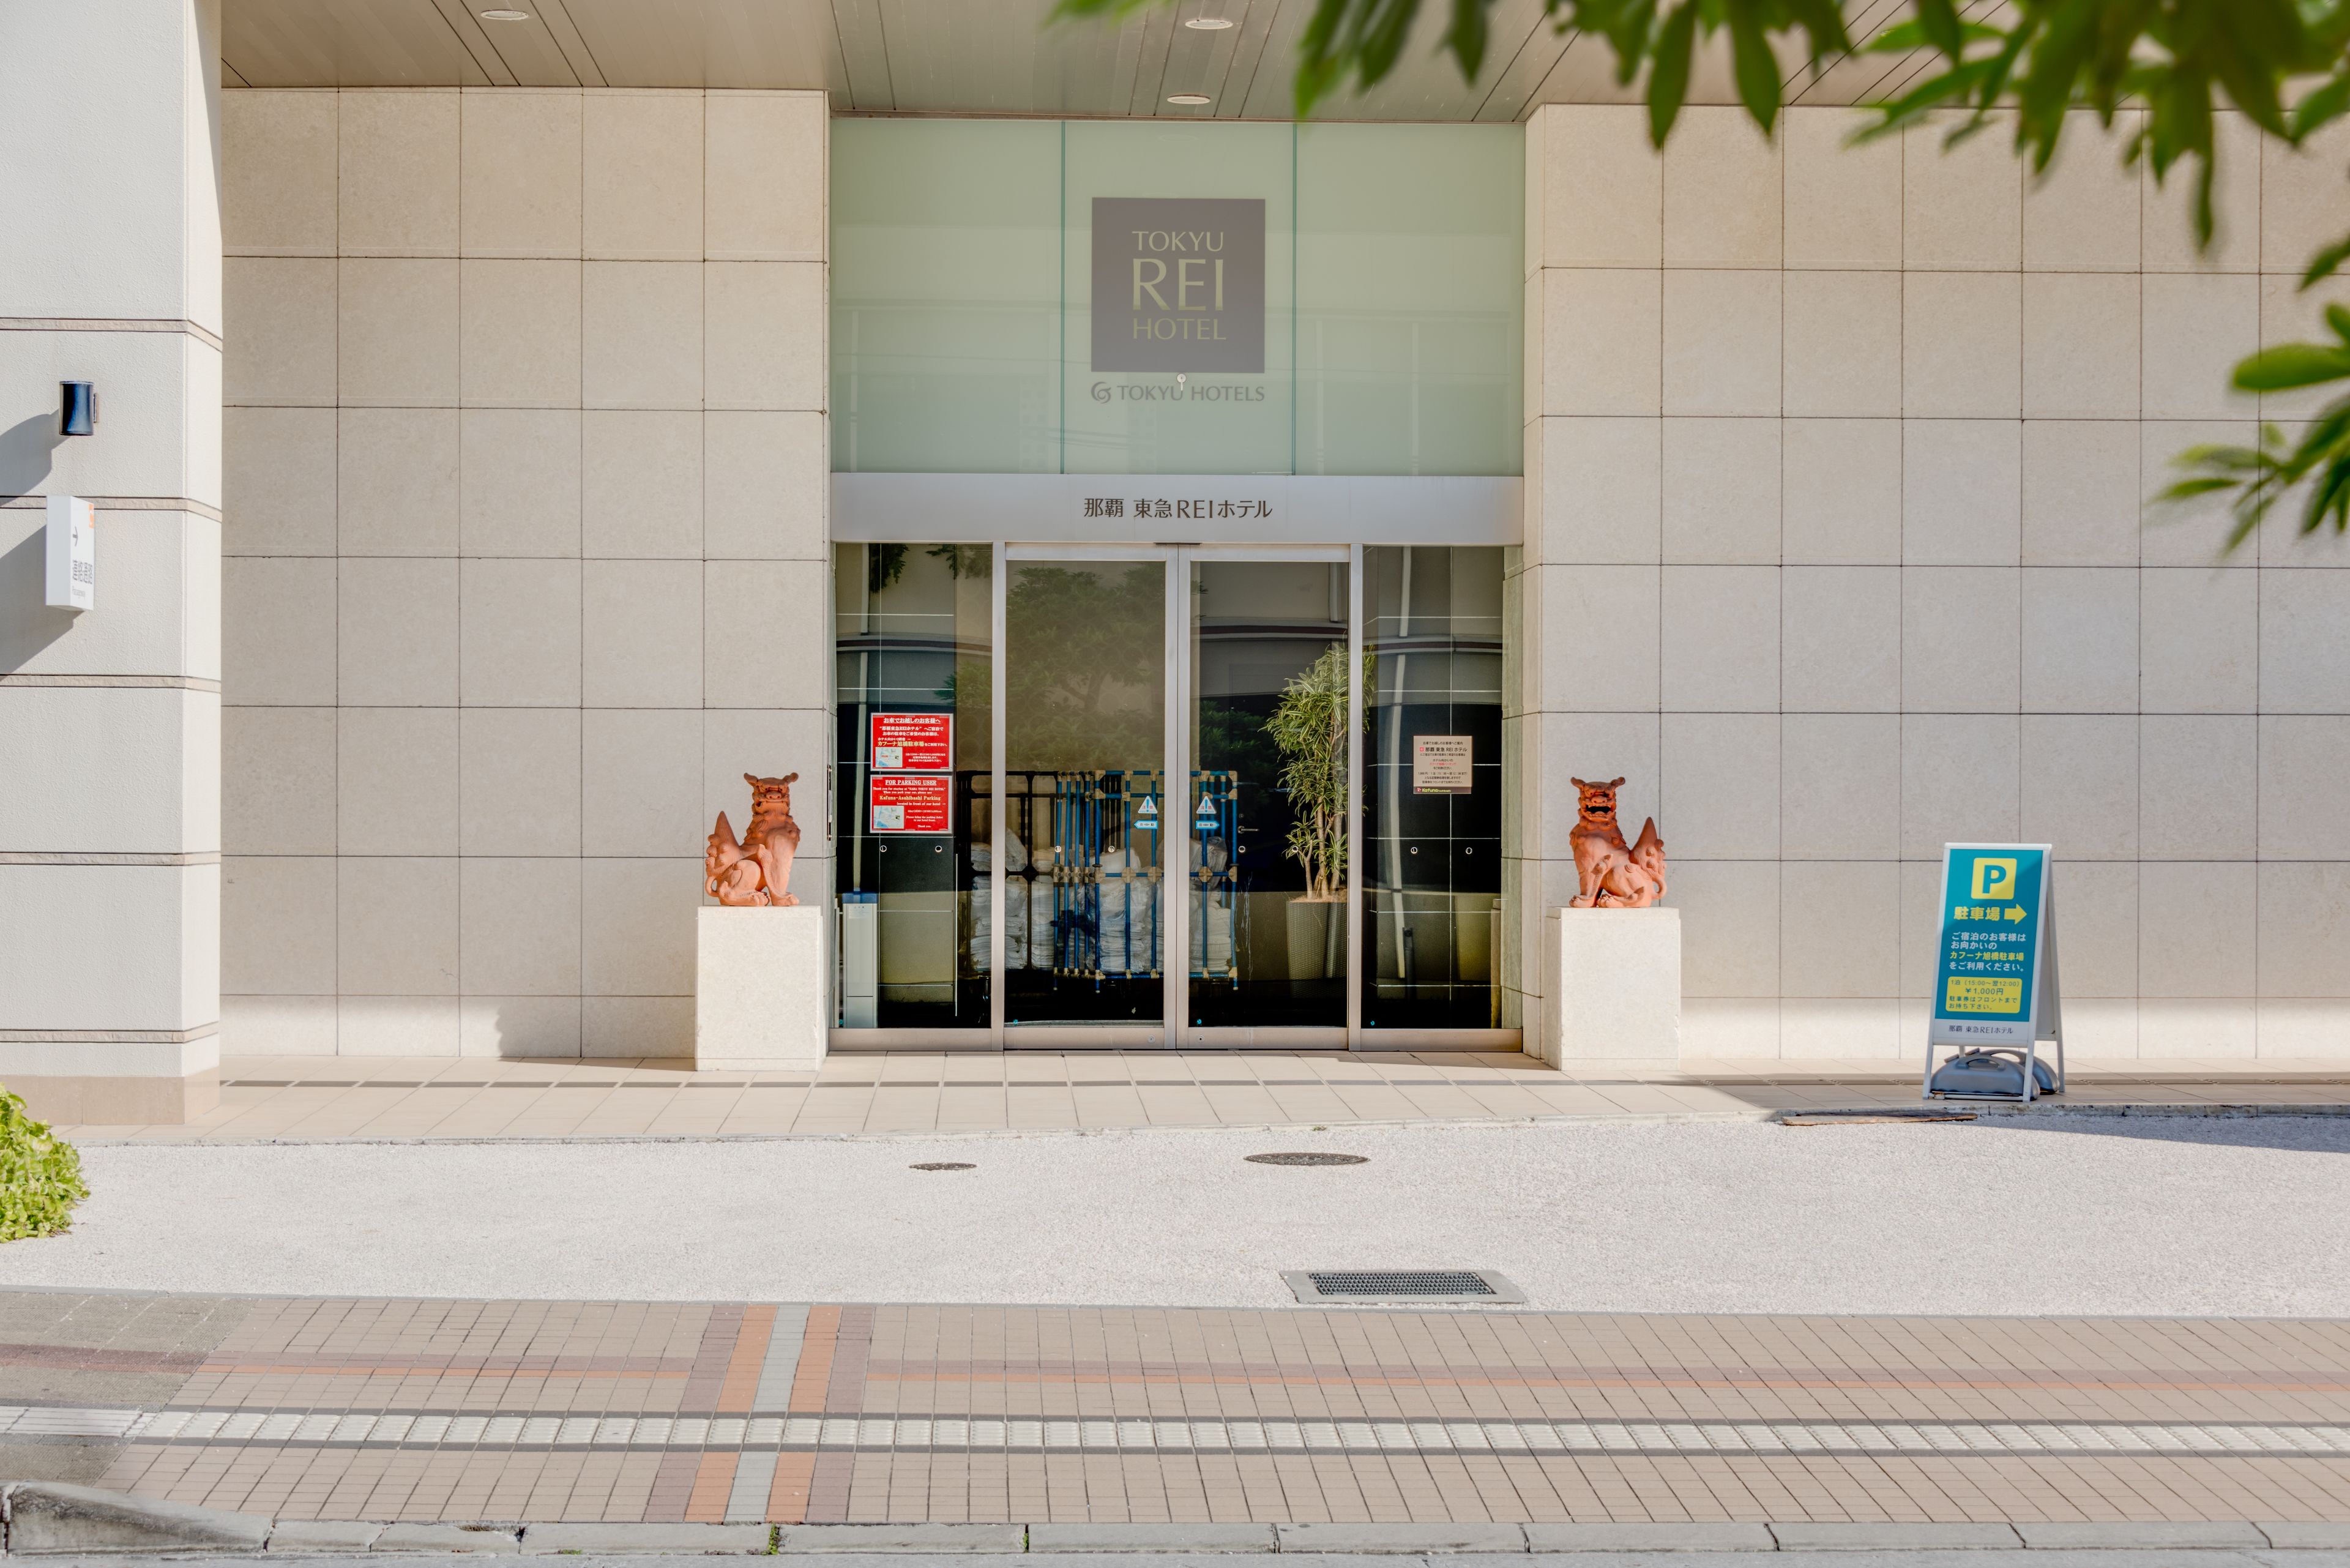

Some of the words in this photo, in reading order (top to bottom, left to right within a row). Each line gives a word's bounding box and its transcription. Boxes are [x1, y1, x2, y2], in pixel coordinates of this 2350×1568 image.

[1132, 231, 1224, 252] TOKYU
[1132, 258, 1224, 311] REI
[1132, 318, 1226, 340] HOTEL
[1117, 386, 1184, 401] TOKYU
[1192, 386, 1265, 401] HOTELS
[1084, 498, 1124, 518] 那覇
[1133, 498, 1273, 518] 東急REIホテル
[1982, 864, 2007, 894] P
[1953, 906, 2000, 921] 駐車場
[1952, 932, 2026, 942] ご宿泊のお客様は
[1950, 951, 2024, 961] カフーナ旭橋駐車場
[1949, 961, 2024, 972] をご利用ください。
[1966, 1026, 2014, 1034] 東急REIホテル
